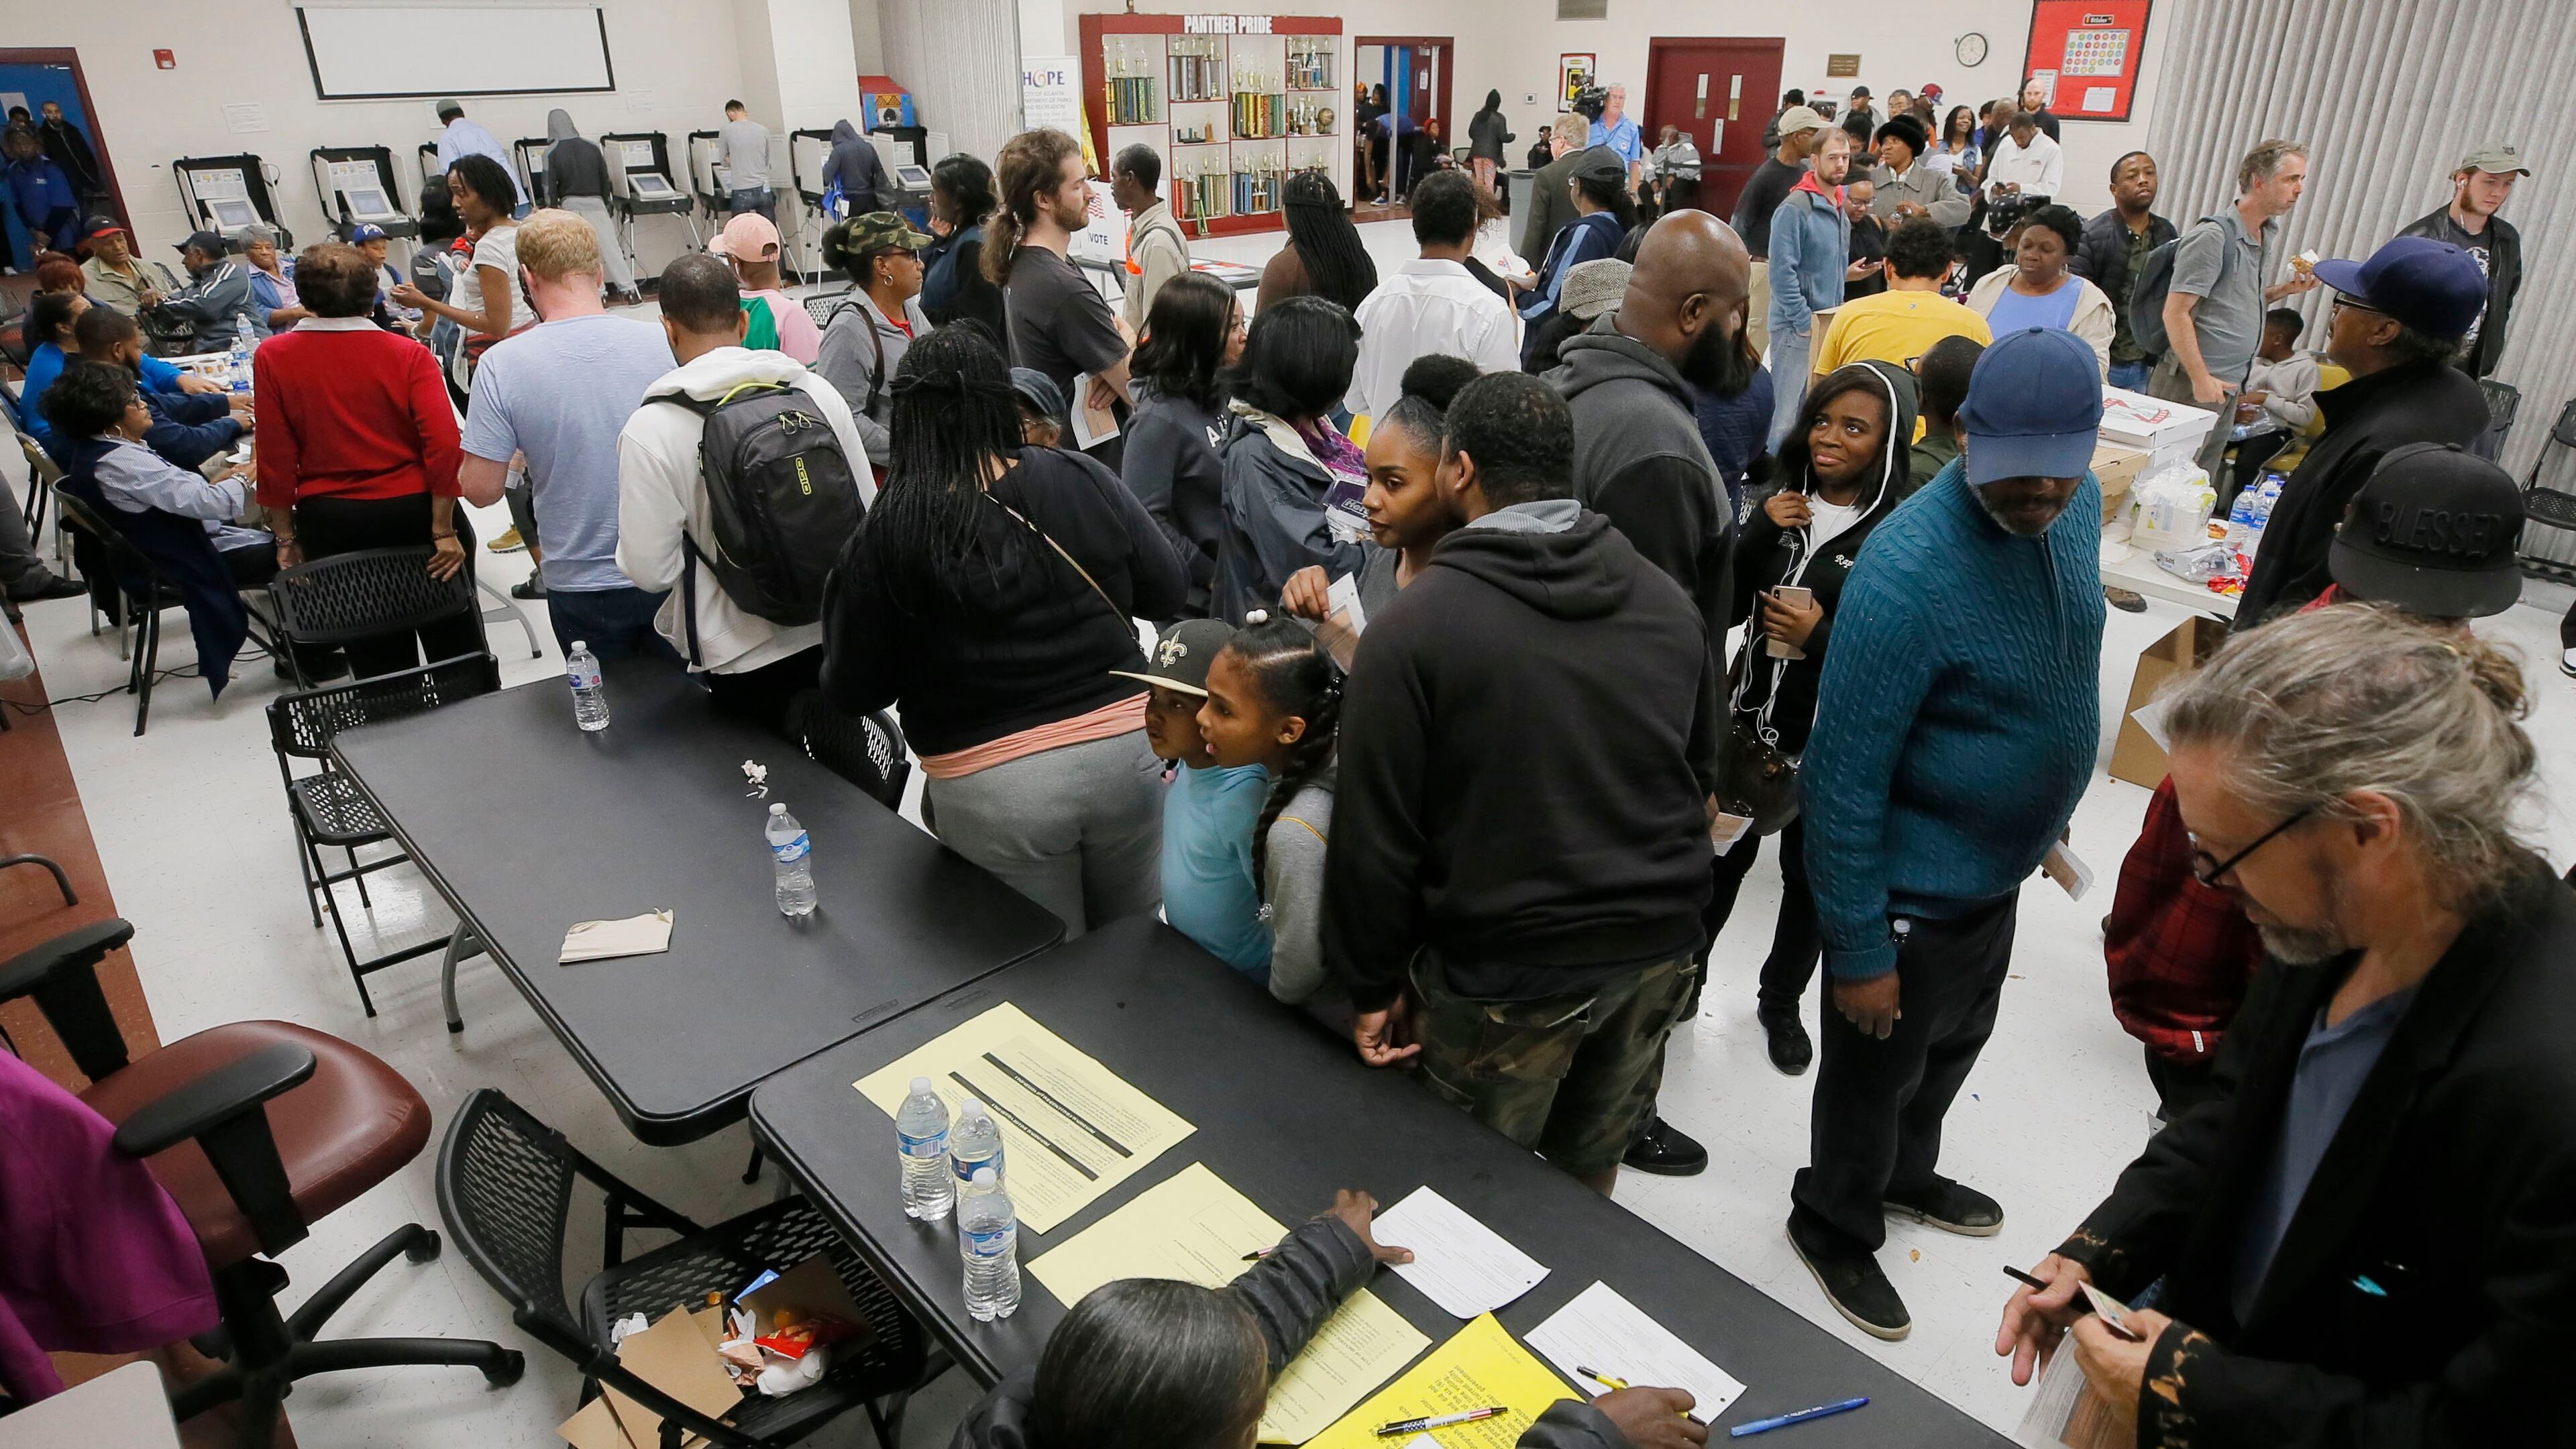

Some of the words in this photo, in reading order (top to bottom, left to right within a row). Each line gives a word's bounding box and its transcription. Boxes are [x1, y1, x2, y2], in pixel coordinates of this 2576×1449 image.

[1184, 15, 1236, 34] PANTHER
[1238, 16, 1273, 34] PRIDE
[1023, 68, 1065, 87] HOPE
[1089, 232, 1108, 246] VOTE
[796, 457, 812, 495] OGIO
[2375, 502, 2502, 558] BLESSED
[1834, 554, 1854, 569] Rap
[1447, 1368, 1464, 1385] utility
[1454, 1364, 1486, 1393] government
[1428, 1384, 1438, 1393] not
[1434, 1379, 1444, 1389] (6)
[1444, 1387, 1452, 1395] six
[1438, 1392, 1448, 1403] did
[1459, 1391, 1473, 1403] time
[1462, 1383, 1483, 1401] current
[1419, 1397, 1439, 1416] elector.
[1447, 1401, 1459, 1413] and
[1452, 1395, 1462, 1405] the
[1486, 1393, 1501, 1407] other
[1398, 1405, 1412, 1418] such
[1513, 1405, 1534, 1425] elector.
